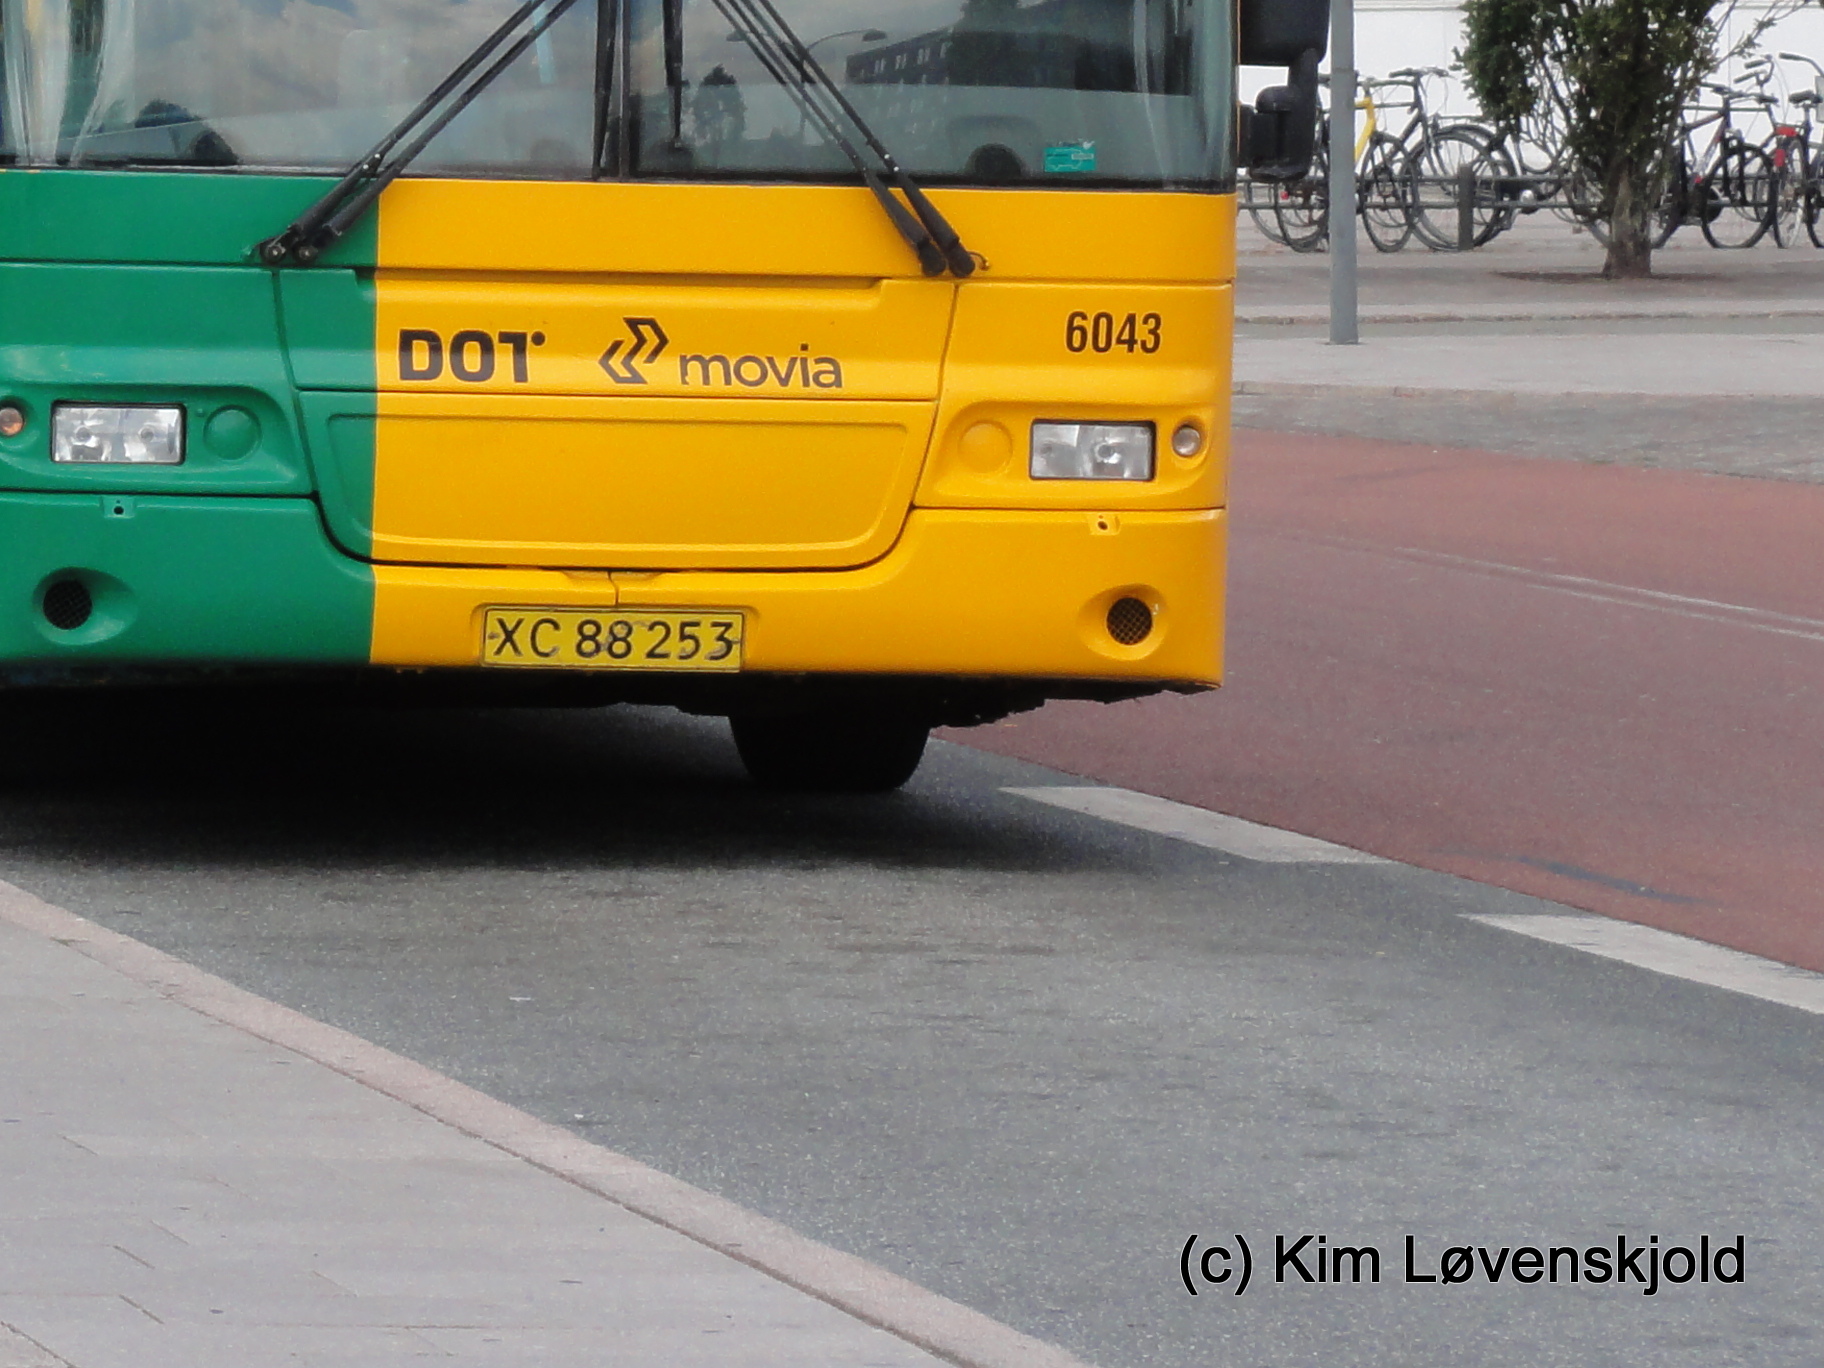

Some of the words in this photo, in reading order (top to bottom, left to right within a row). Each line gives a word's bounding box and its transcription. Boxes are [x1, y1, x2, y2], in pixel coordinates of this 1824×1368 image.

[1065, 311, 1162, 354] 6043
[398, 328, 531, 384] DOT
[679, 343, 844, 389] movia
[493, 618, 562, 657] XC
[576, 619, 633, 660] 88
[645, 620, 735, 661] 253
